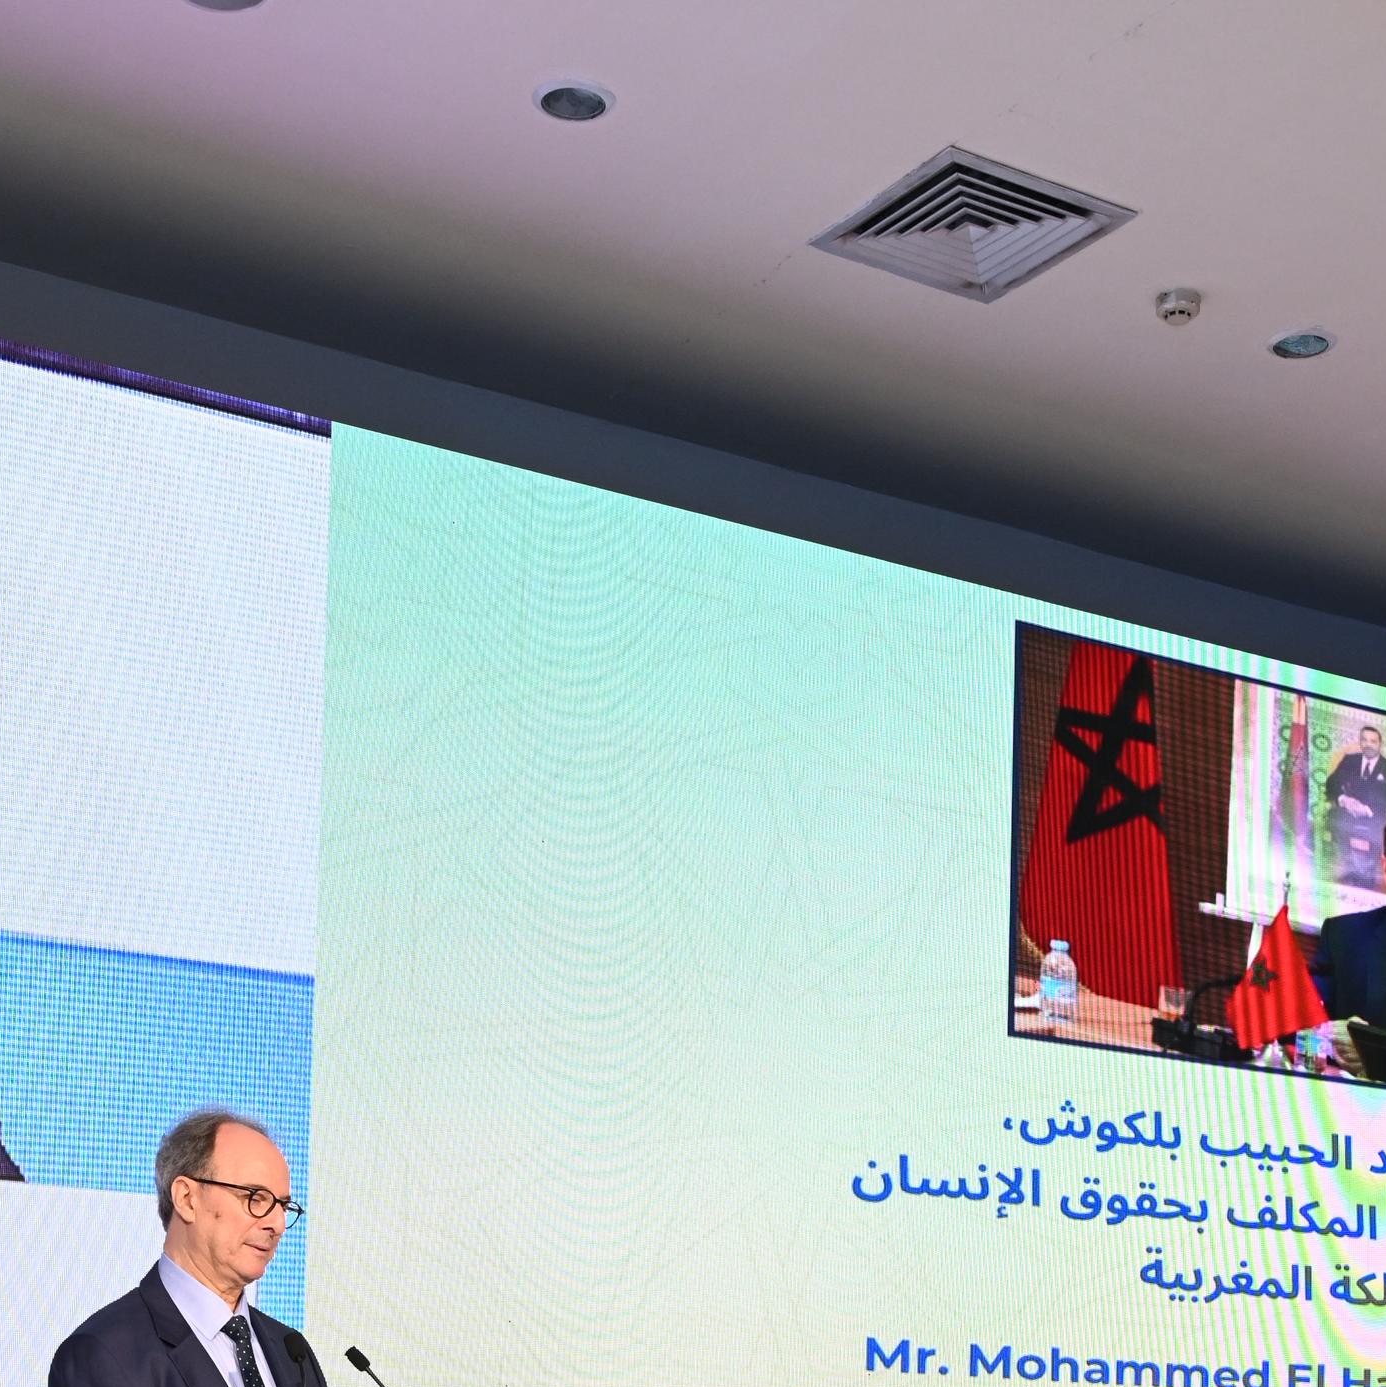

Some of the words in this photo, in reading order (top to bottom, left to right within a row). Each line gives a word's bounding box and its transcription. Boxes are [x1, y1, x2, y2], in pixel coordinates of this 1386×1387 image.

[1001, 1099, 1183, 1153] بلكوش،
[1199, 1133, 1353, 1180] الحبيب
[851, 1153, 1041, 1219] الإنسان
[1059, 1176, 1210, 1235] بحقوق
[1226, 1194, 1378, 1240] المكلف
[1139, 1246, 1314, 1304] المغربية
[865, 1336, 949, 1376] Mr.
